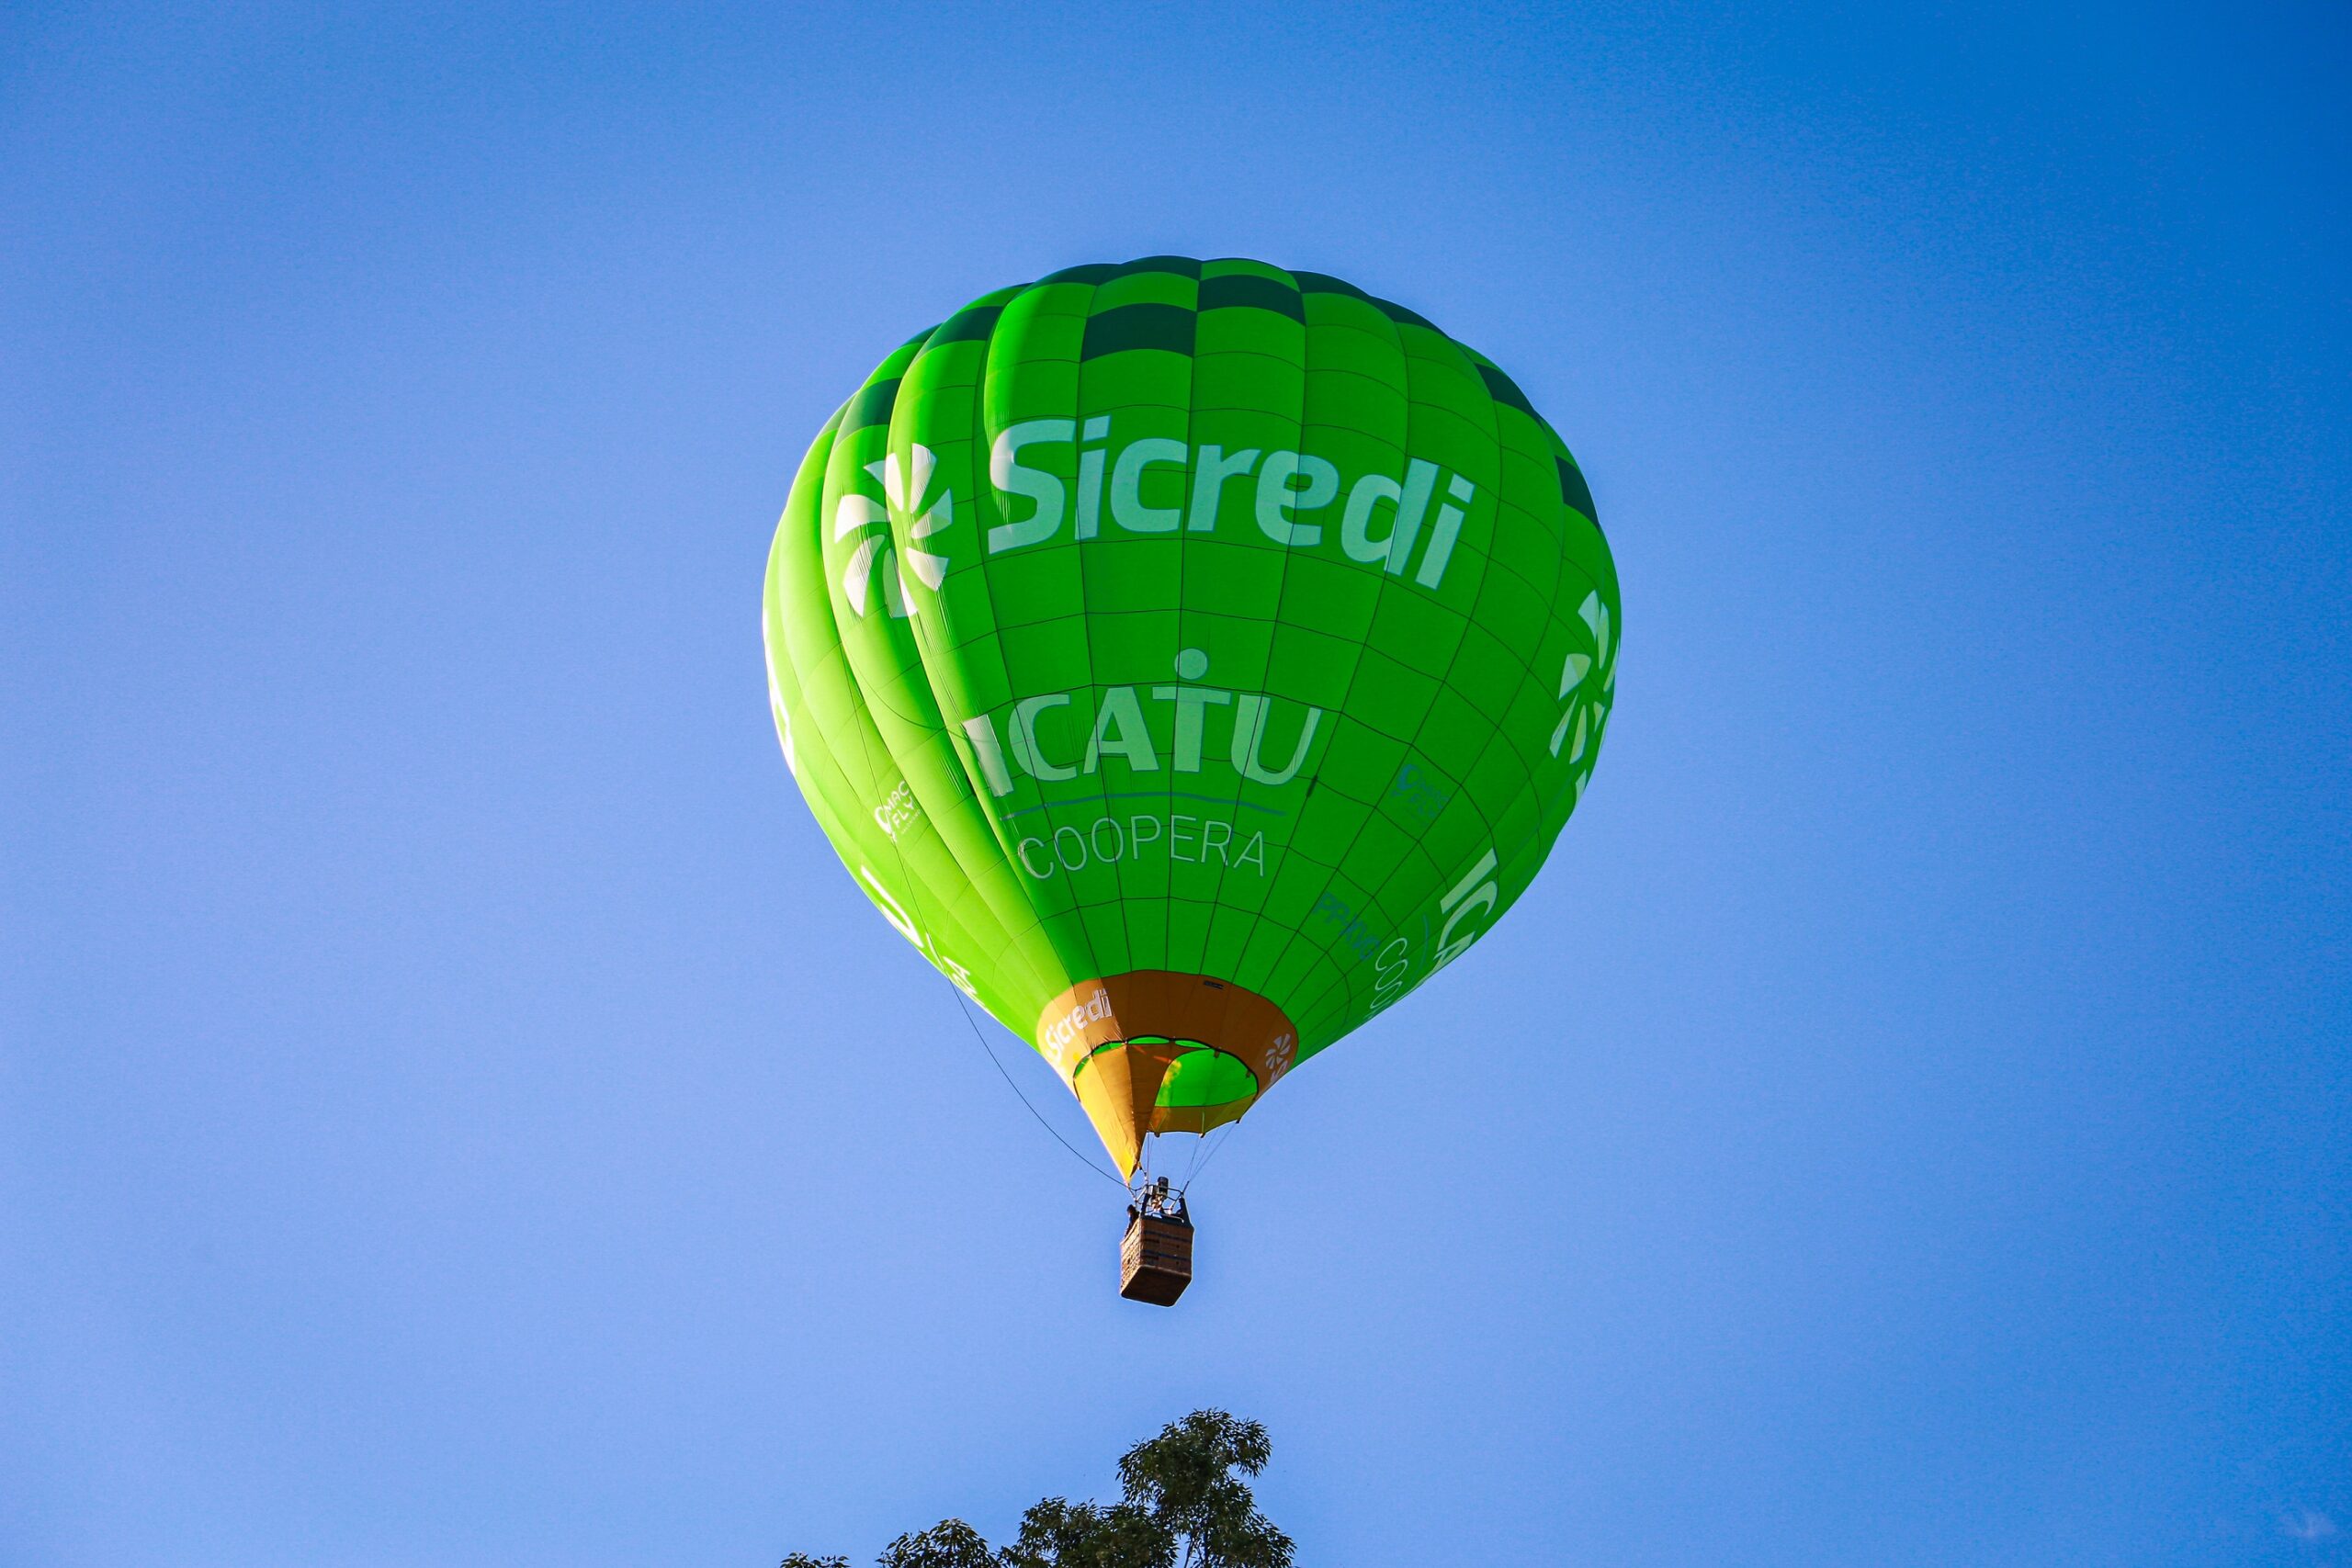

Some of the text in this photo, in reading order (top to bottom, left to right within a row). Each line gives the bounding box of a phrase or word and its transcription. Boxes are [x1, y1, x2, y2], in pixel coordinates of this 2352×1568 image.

[988, 415, 1476, 591] Sicredi
[963, 648, 1322, 797] ICATU
[884, 780, 910, 817] MAC
[1017, 814, 1267, 881] COOPERA
[1045, 987, 1113, 1064] Sicredi
